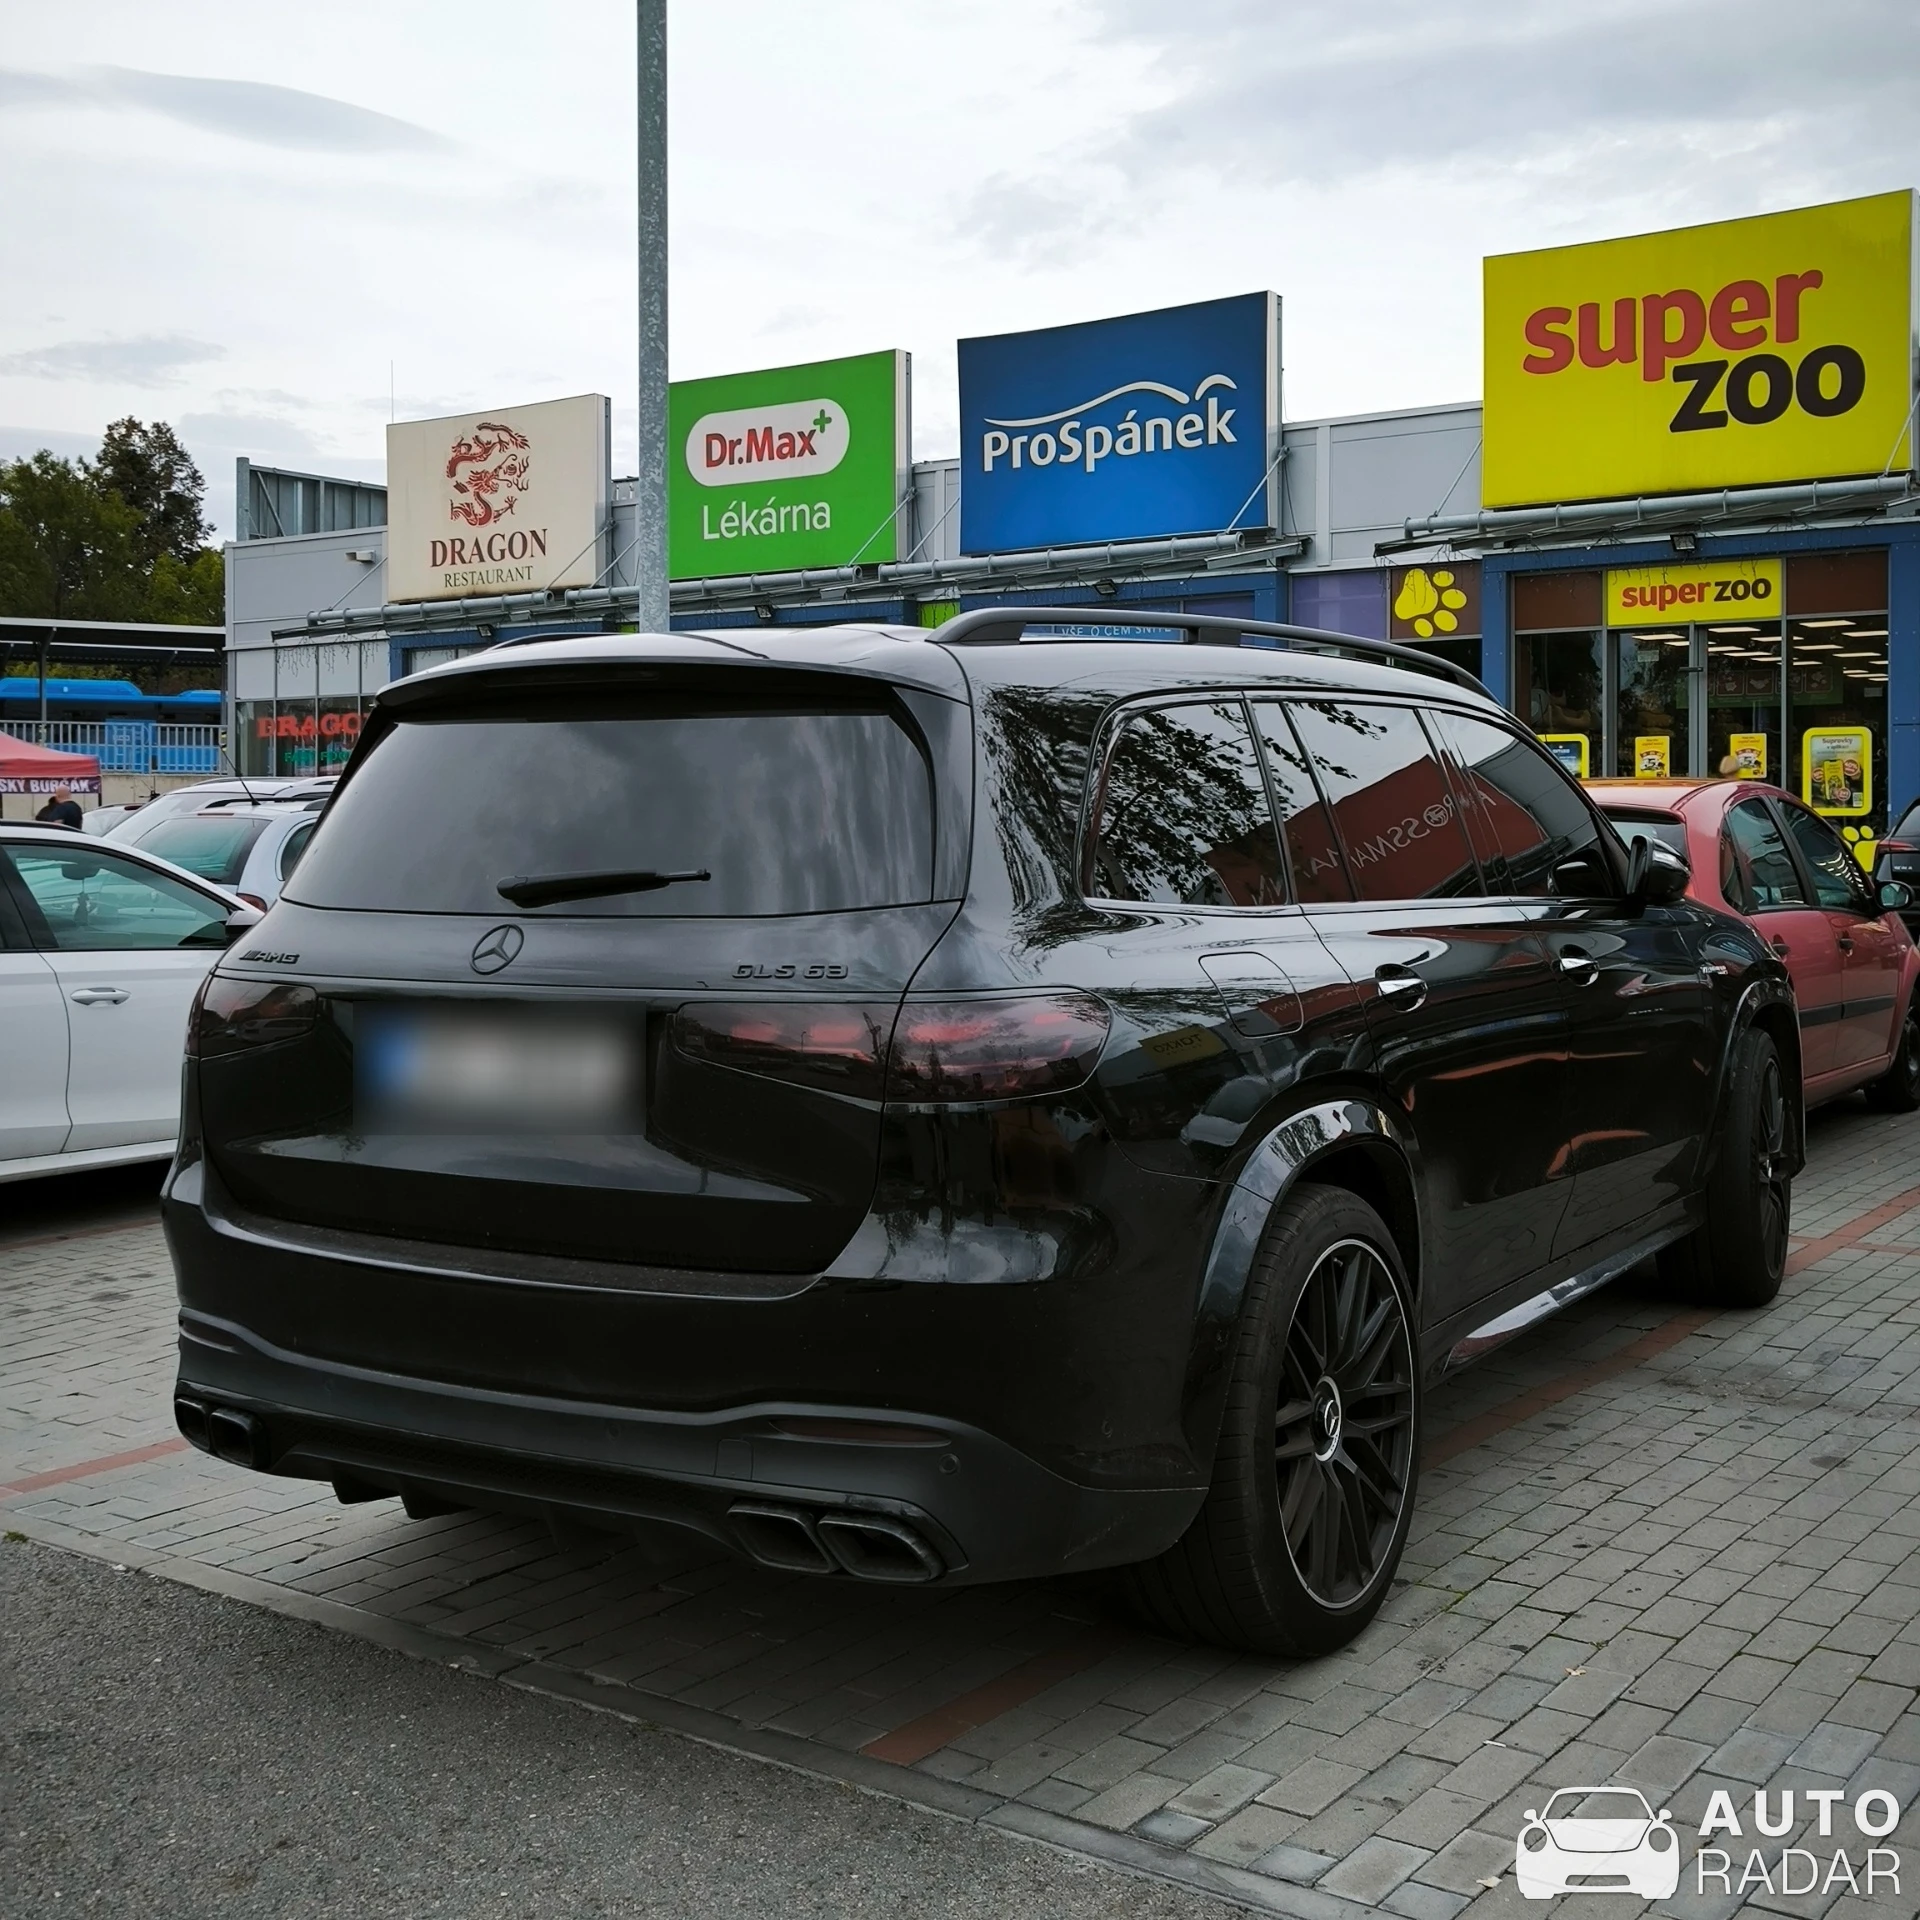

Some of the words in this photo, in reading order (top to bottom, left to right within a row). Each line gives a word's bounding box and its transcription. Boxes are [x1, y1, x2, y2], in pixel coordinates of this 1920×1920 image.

[1523, 269, 1824, 382] super
[1669, 344, 1866, 433] zoo
[705, 426, 818, 468] Dr.Max
[983, 397, 1238, 473] ProSpánek
[703, 496, 831, 540] Lékárna
[430, 528, 548, 568] DRAGON
[444, 565, 534, 588] RESTAURANT
[1622, 582, 1711, 611] super
[1714, 578, 1772, 602] zoo
[1090, 625, 1100, 637] O
[257, 712, 371, 738] DRAGO
[732, 964, 796, 979] GLS
[804, 964, 849, 980] 63
